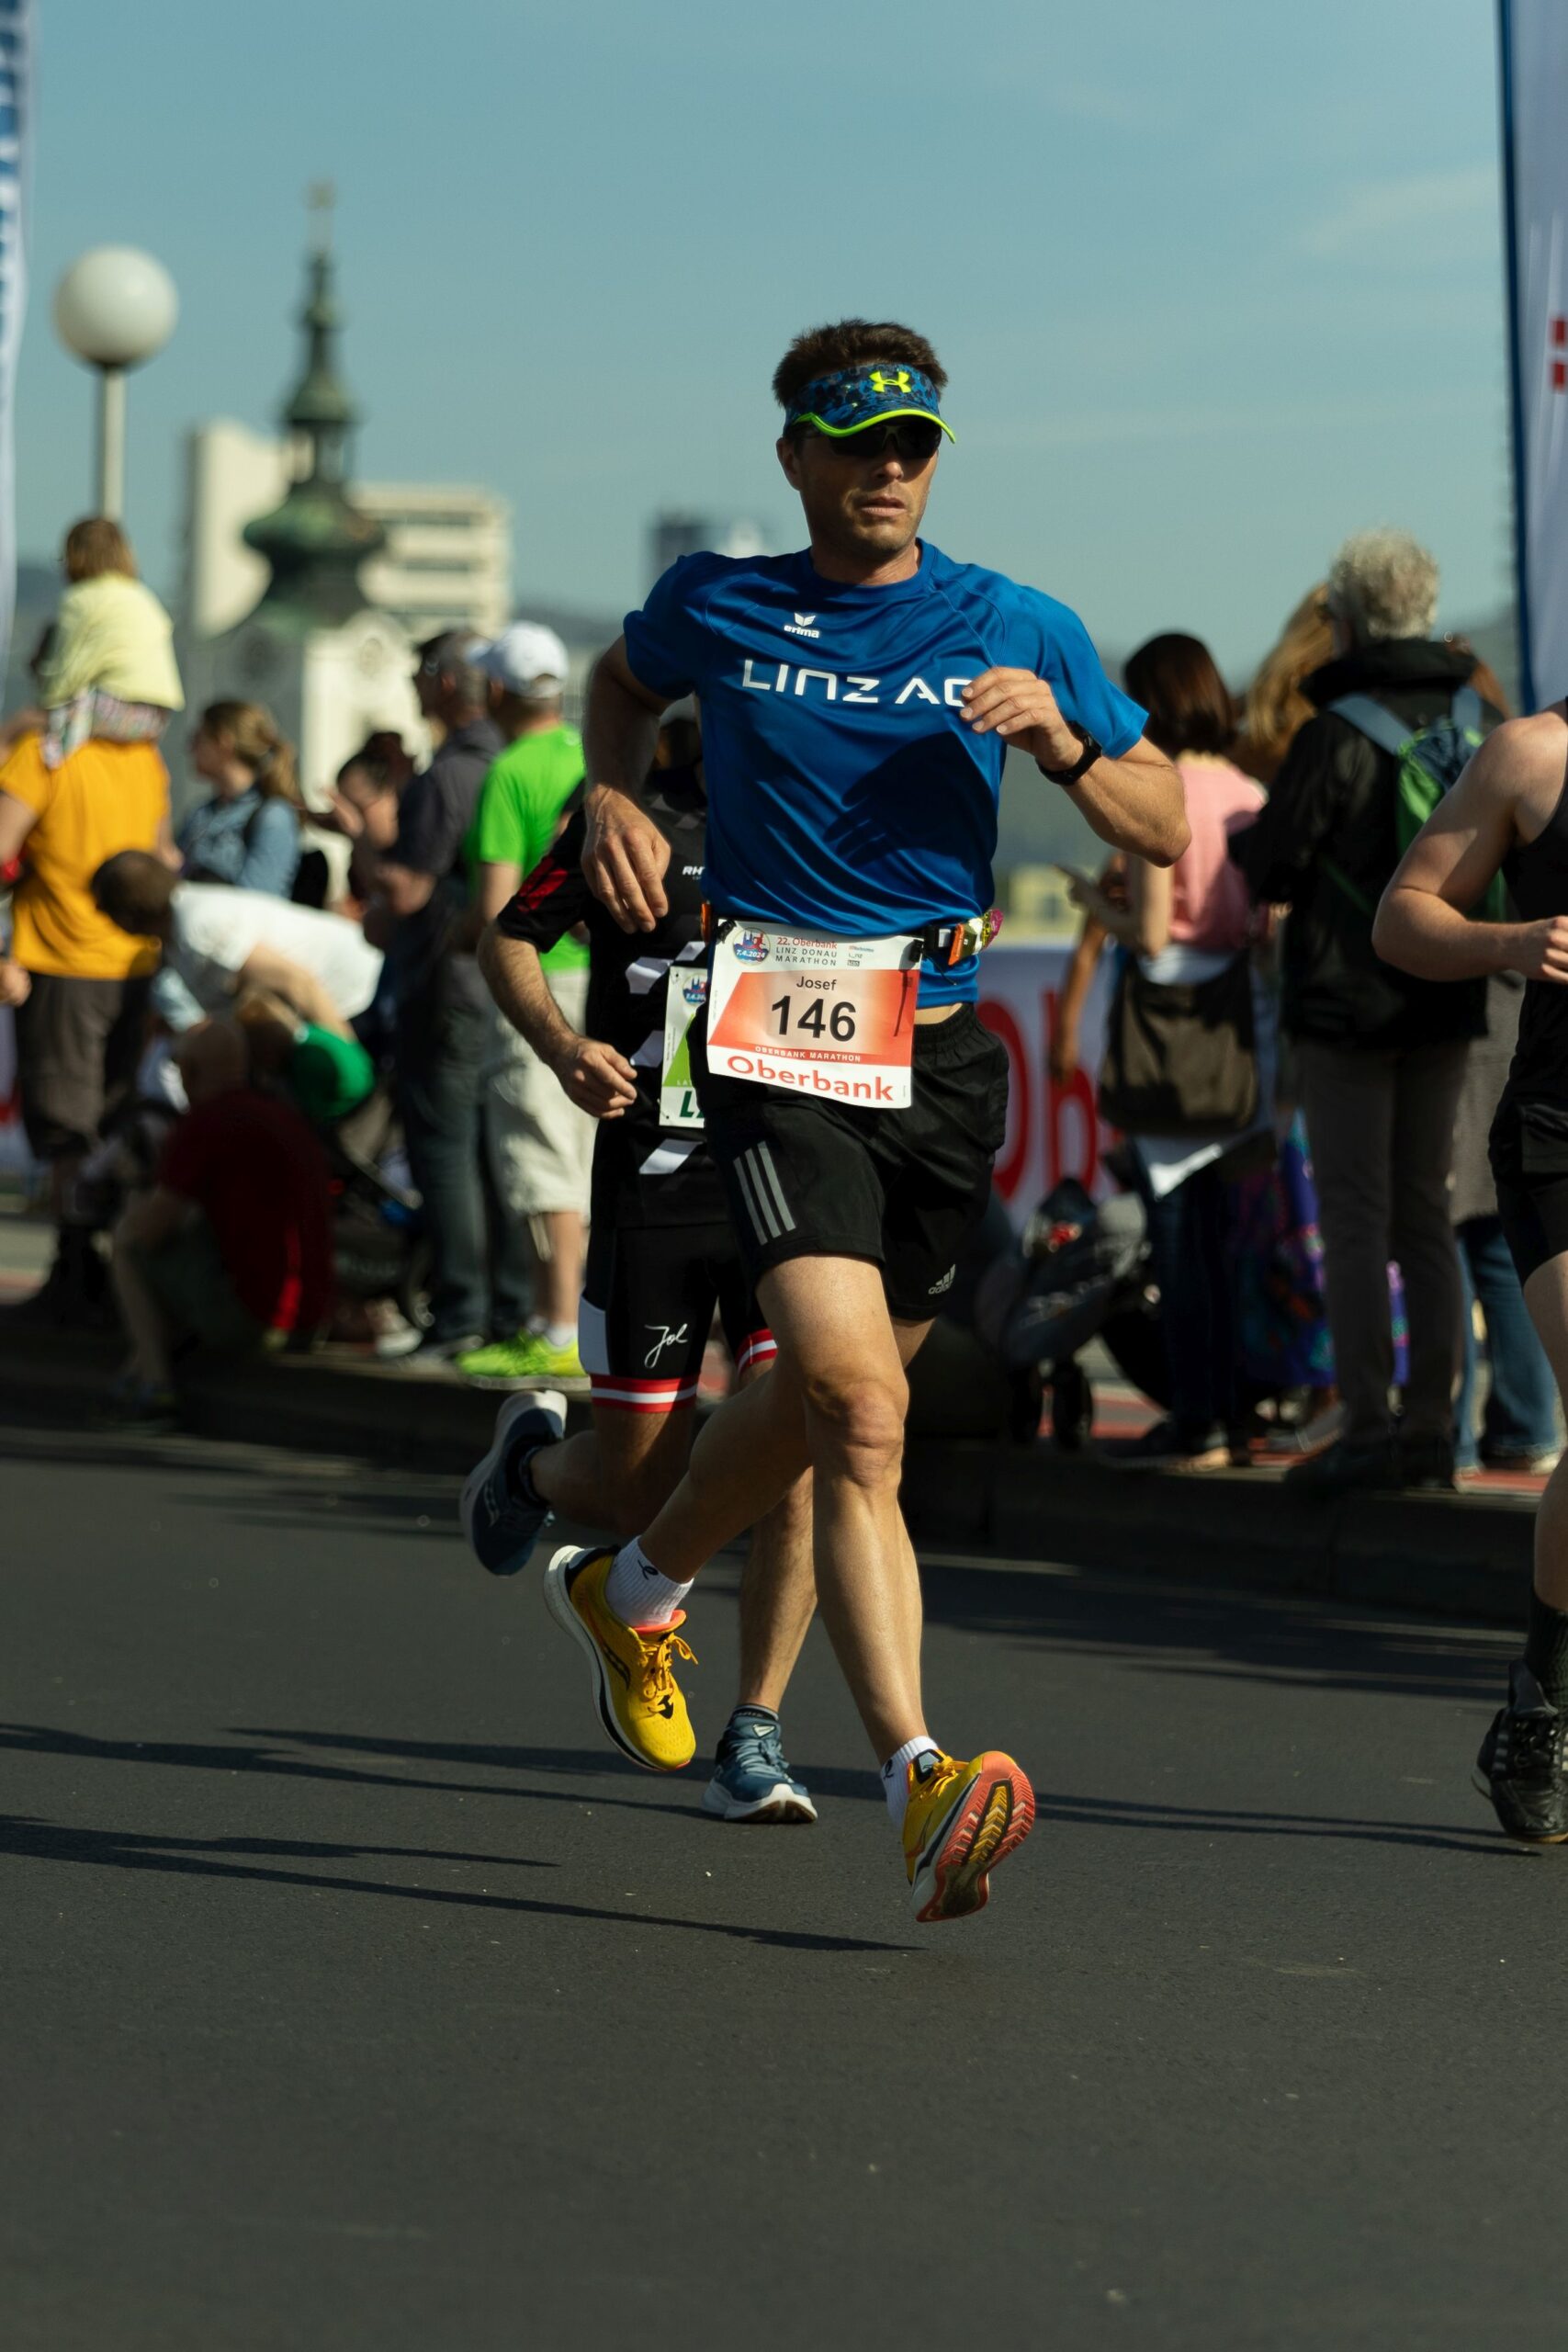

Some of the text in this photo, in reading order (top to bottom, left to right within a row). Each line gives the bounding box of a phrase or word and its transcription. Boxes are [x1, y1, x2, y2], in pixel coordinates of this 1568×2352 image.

[784, 624, 819, 639] erima
[777, 937, 791, 946] 22.
[793, 937, 838, 949] Oberbank
[775, 946, 797, 955] LINZ
[802, 948, 838, 958] DONAU
[775, 956, 837, 967] MARATHON
[796, 975, 838, 990] Josef
[772, 995, 857, 1042] 146
[755, 1046, 861, 1062] OBERBANK MARATHON
[727, 1056, 894, 1102] Oberbank
